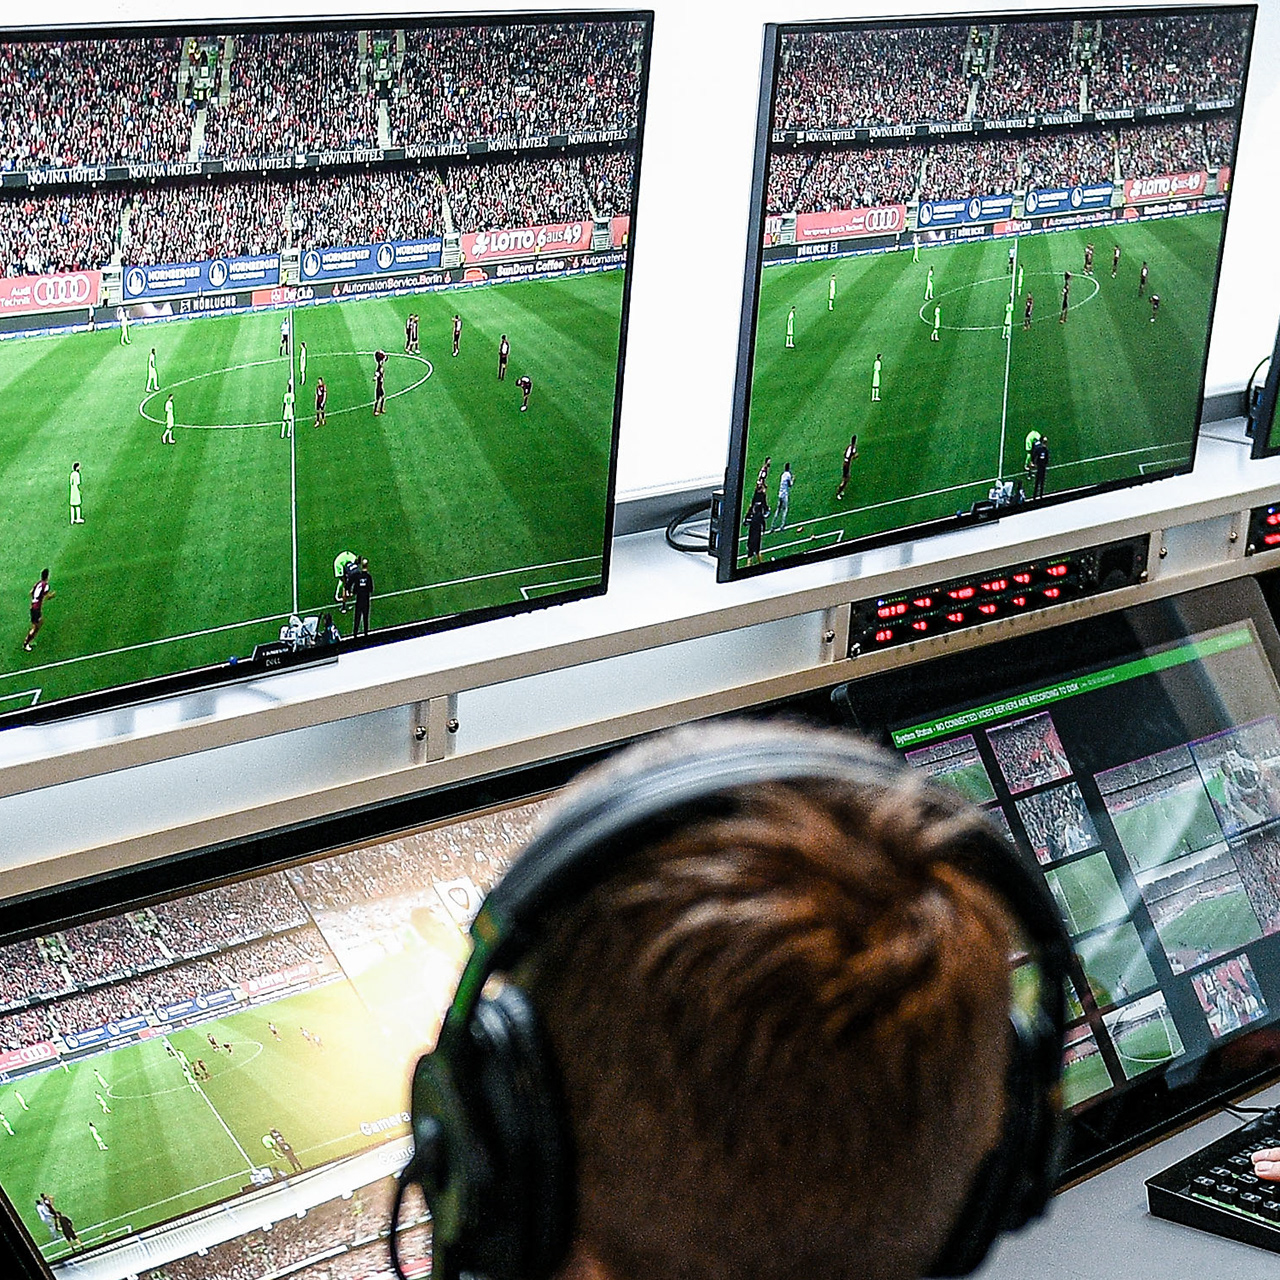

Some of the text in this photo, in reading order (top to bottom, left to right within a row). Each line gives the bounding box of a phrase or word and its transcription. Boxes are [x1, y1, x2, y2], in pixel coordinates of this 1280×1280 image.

[488, 136, 548, 152] NOVINA HOTELS
[568, 130, 628, 144] NOVINA HOTELS
[318, 150, 384, 166] NOVINA HOTELS
[405, 144, 468, 159] NOVINA HOTELS
[129, 162, 202, 178] NOVINA HOTELS
[223, 156, 292, 172] NOVINA HOTELS
[27, 167, 106, 185] NOVINA HOTELS
[490, 230, 534, 252] LOTTO
[11, 286, 32, 297] Audi
[360, 1111, 412, 1136] Camera
